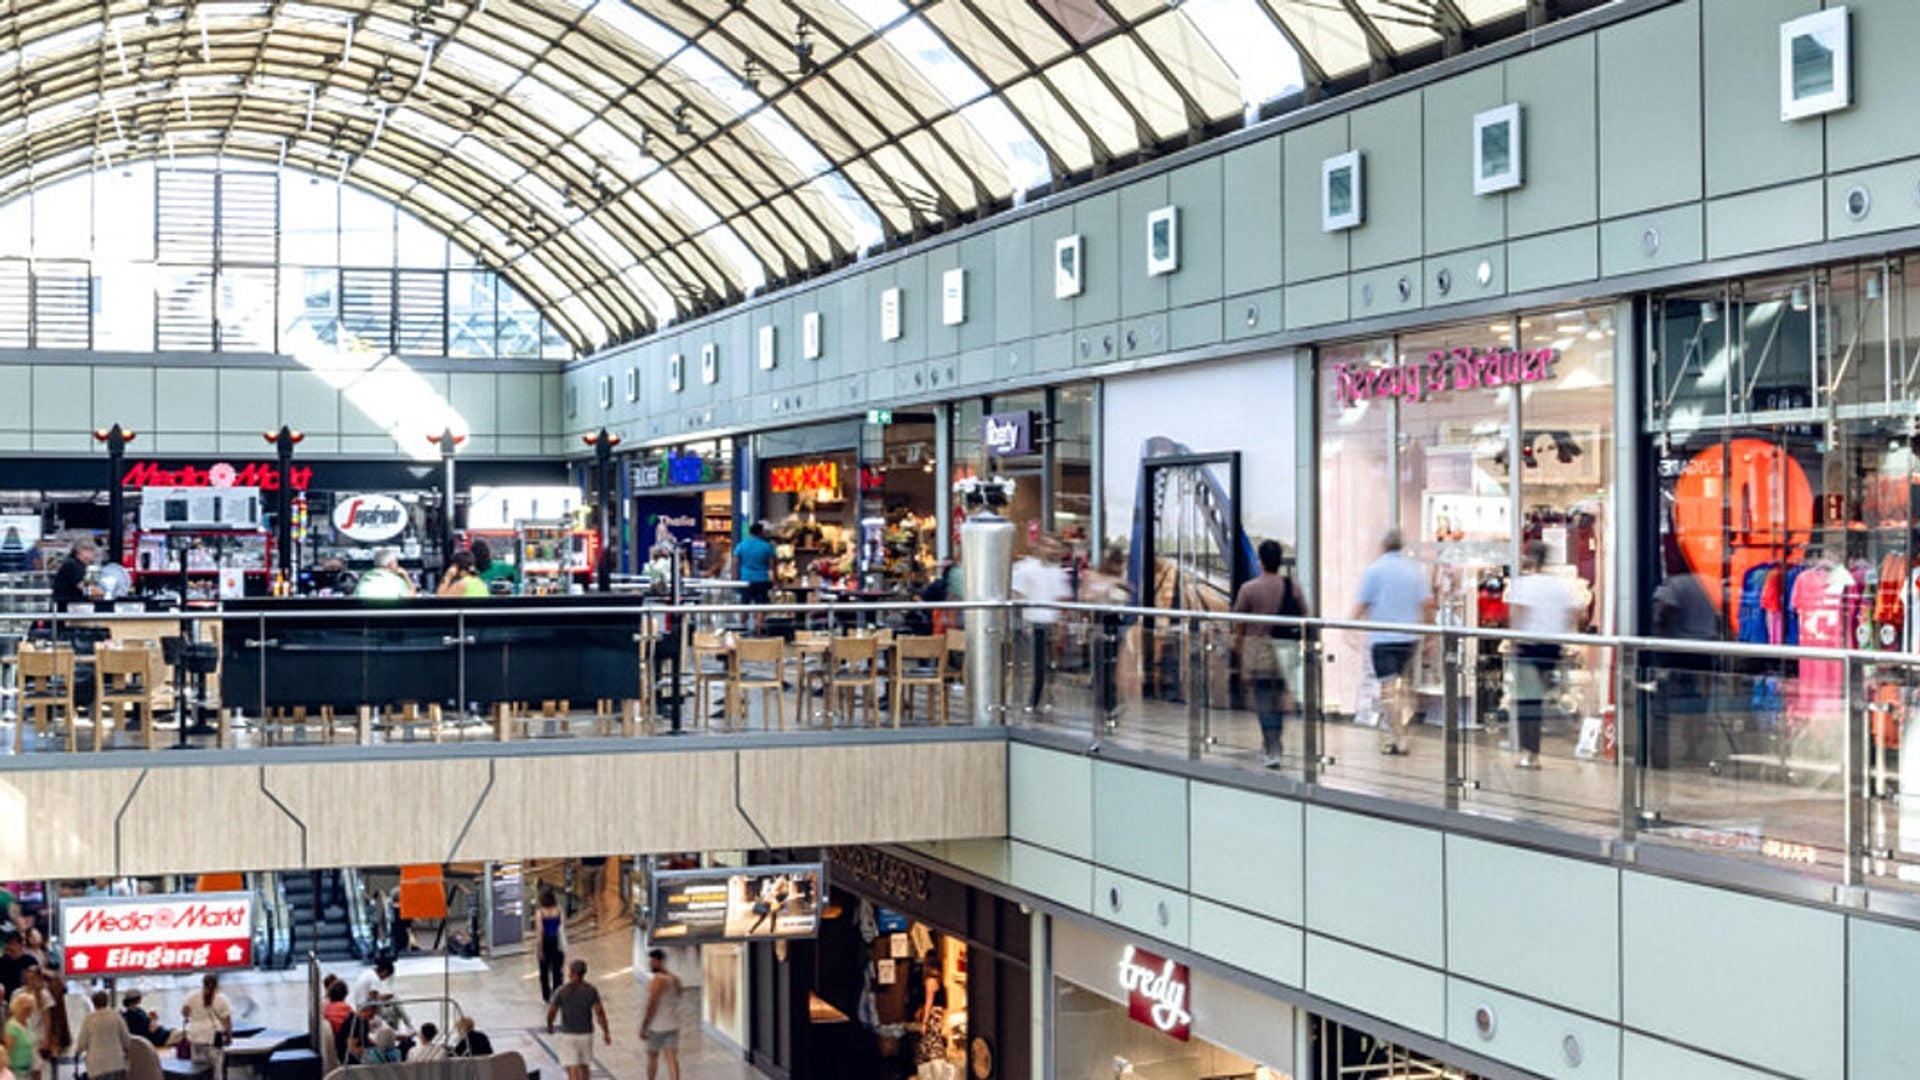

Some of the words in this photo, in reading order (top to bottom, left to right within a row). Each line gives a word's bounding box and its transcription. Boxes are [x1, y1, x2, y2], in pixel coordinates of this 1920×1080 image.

[122, 461, 210, 489] Media
[232, 462, 313, 490] Makt
[657, 514, 696, 528] Thalia
[70, 908, 155, 935] Media
[172, 904, 247, 929] Markt
[105, 942, 211, 969] Eingang
[1118, 944, 1192, 1031] tredy
